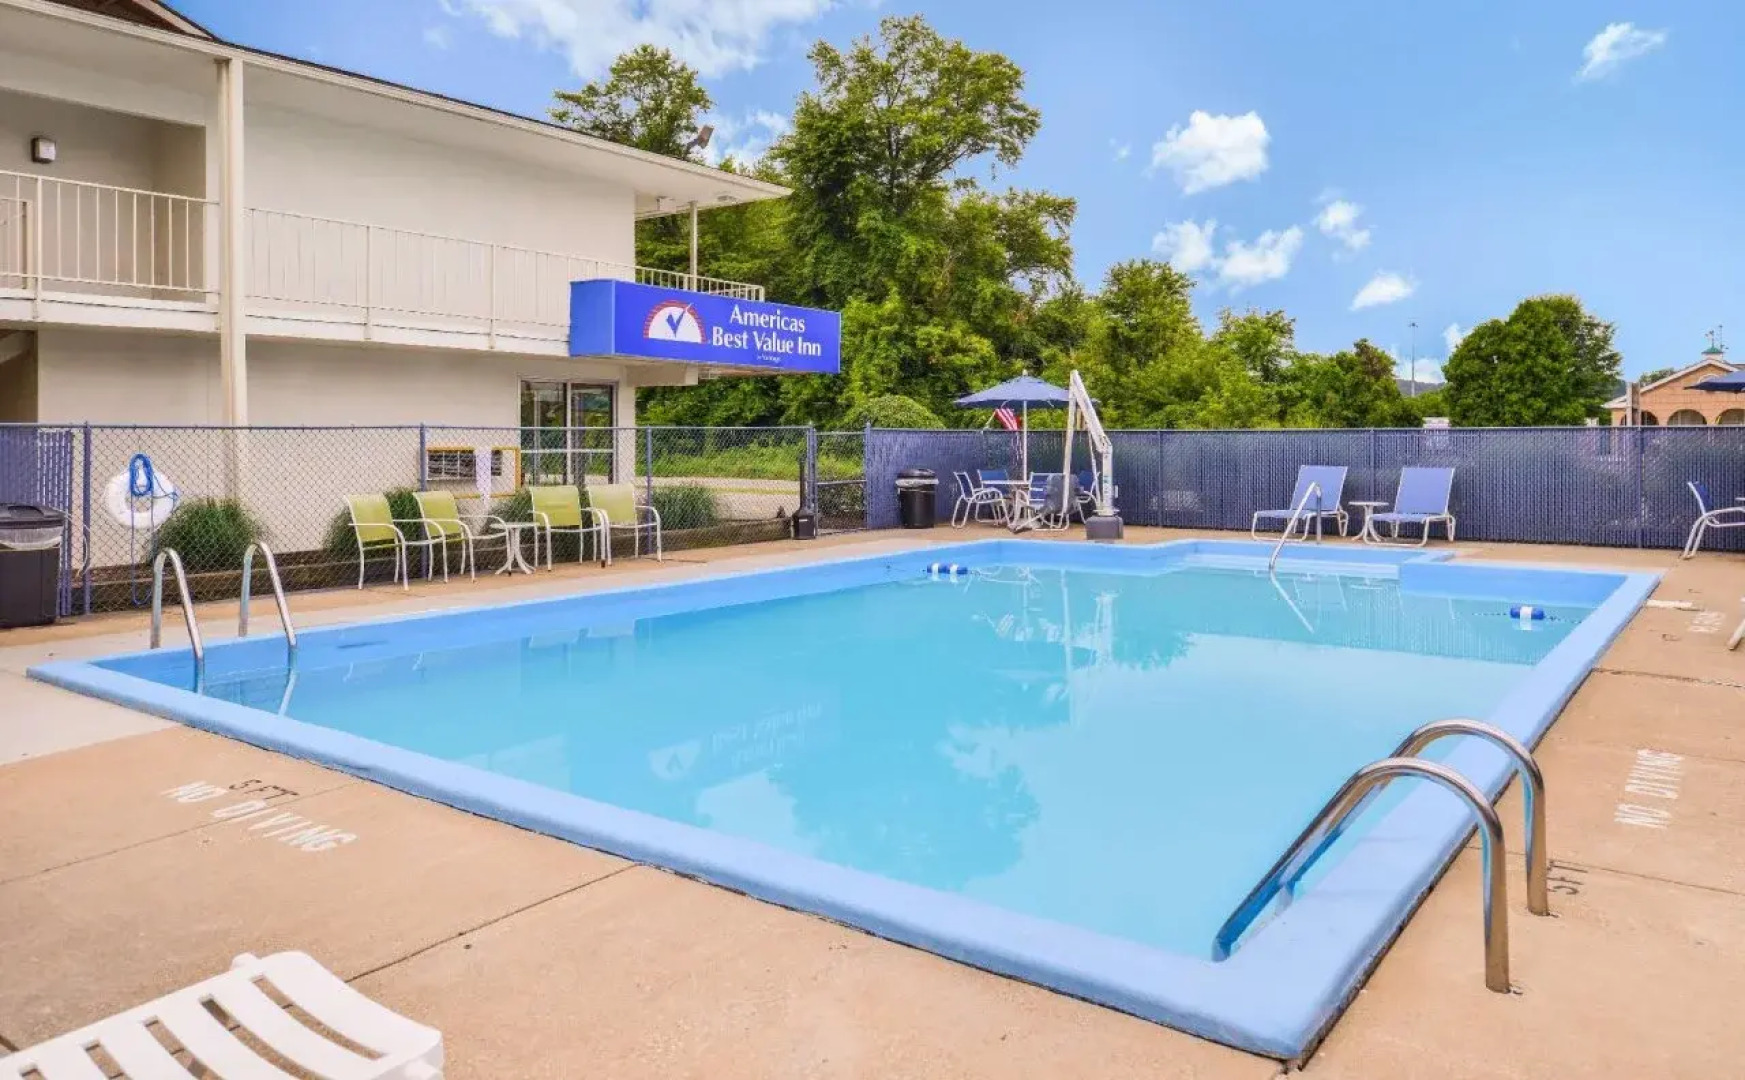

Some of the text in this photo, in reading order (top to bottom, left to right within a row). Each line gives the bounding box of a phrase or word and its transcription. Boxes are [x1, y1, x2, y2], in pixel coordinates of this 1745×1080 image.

[712, 326, 822, 357] Best Value Inn
[729, 304, 805, 332] Americas
[1614, 749, 1685, 829] NO DIVING
[159, 780, 358, 851] NO DIVING
